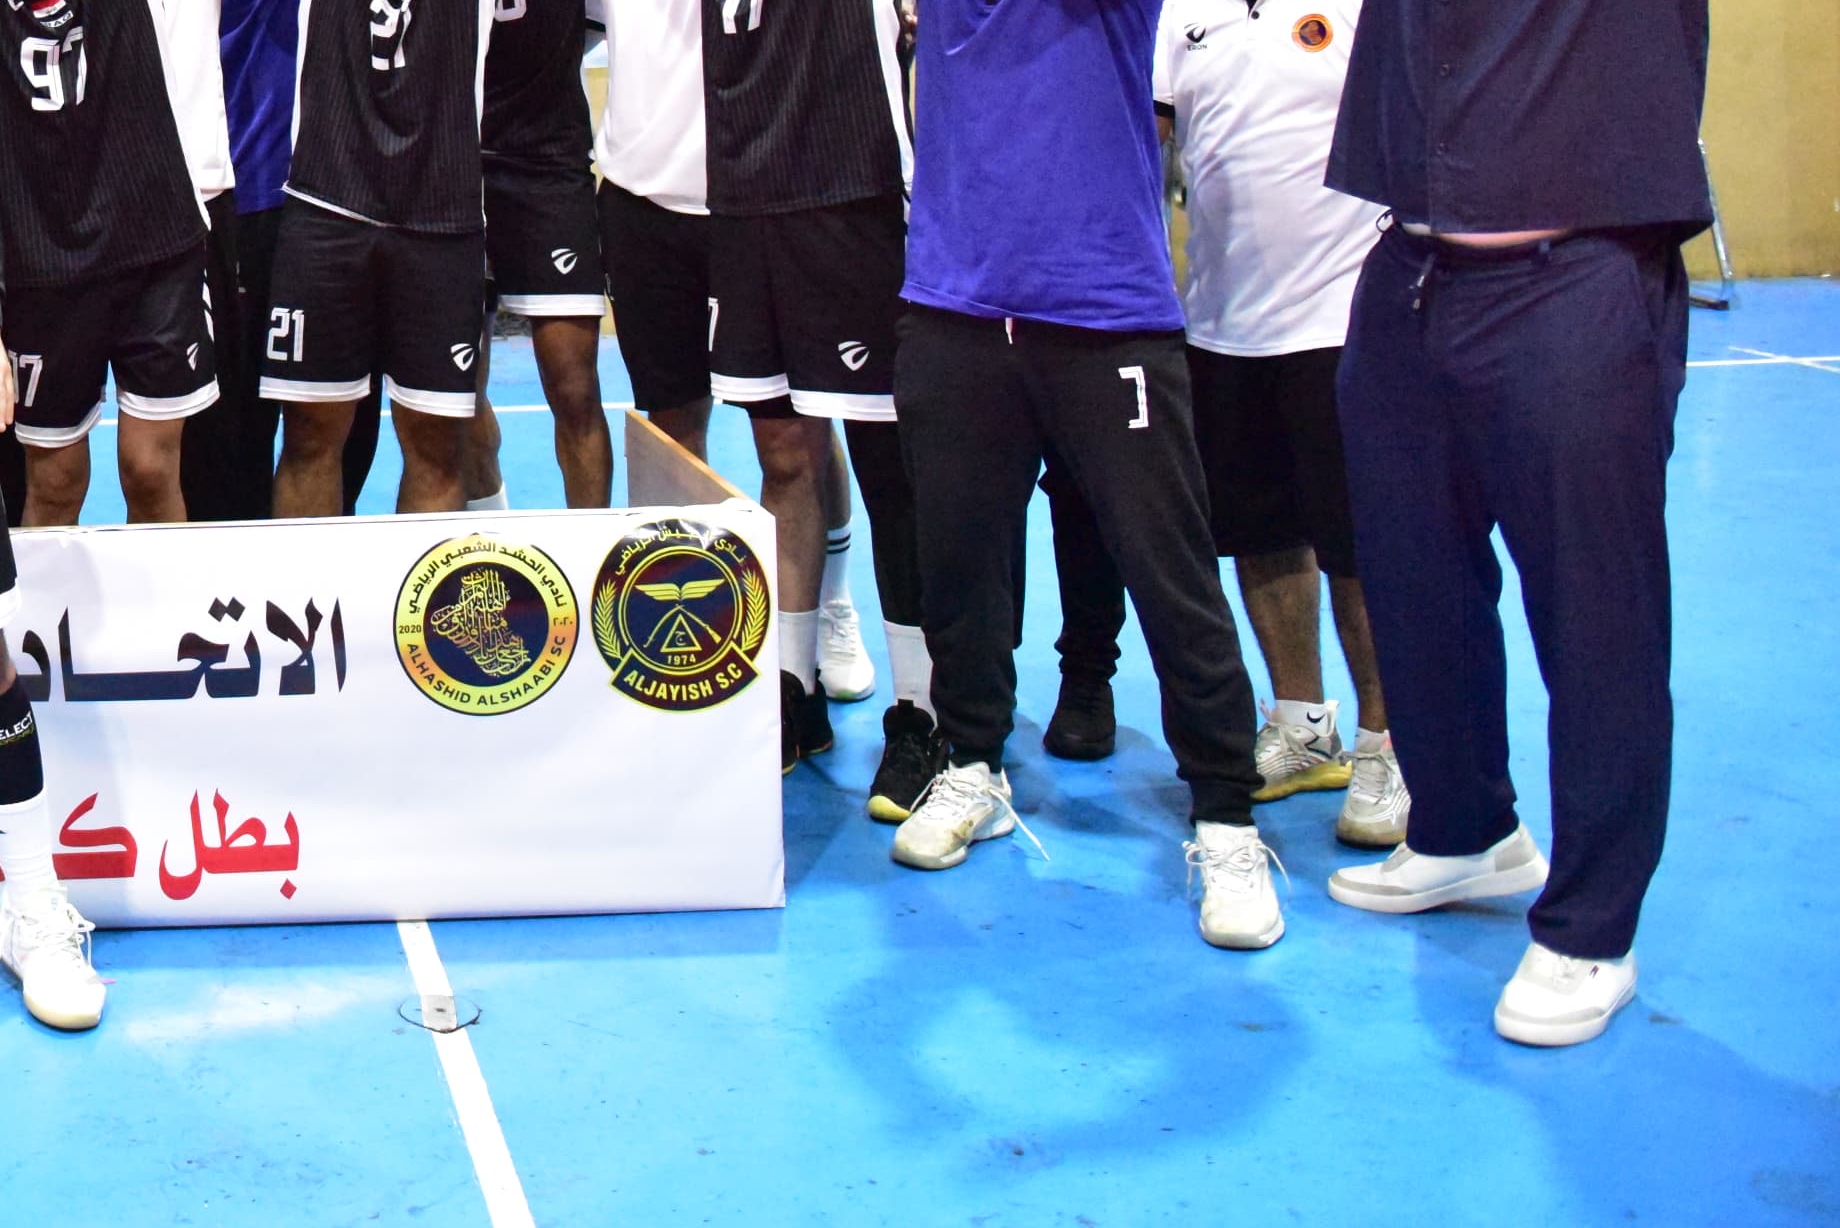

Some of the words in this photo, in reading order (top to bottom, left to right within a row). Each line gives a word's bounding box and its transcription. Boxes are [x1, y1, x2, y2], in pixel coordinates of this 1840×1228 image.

[266, 308, 306, 362] 21
[440, 541, 496, 569] الشعبي
[499, 546, 546, 576] الحشد
[714, 537, 748, 566] نادي
[409, 560, 440, 614] الرياضي
[539, 574, 568, 608] نادي
[398, 624, 422, 634] 2020
[407, 643, 472, 704] ALHASHID
[476, 661, 556, 706] ALSHAABI
[551, 635, 567, 657] SC
[667, 655, 697, 666] 1974
[623, 669, 714, 702] ALJAYISH
[715, 662, 743, 690] S.C
[159, 786, 300, 901] بطل
